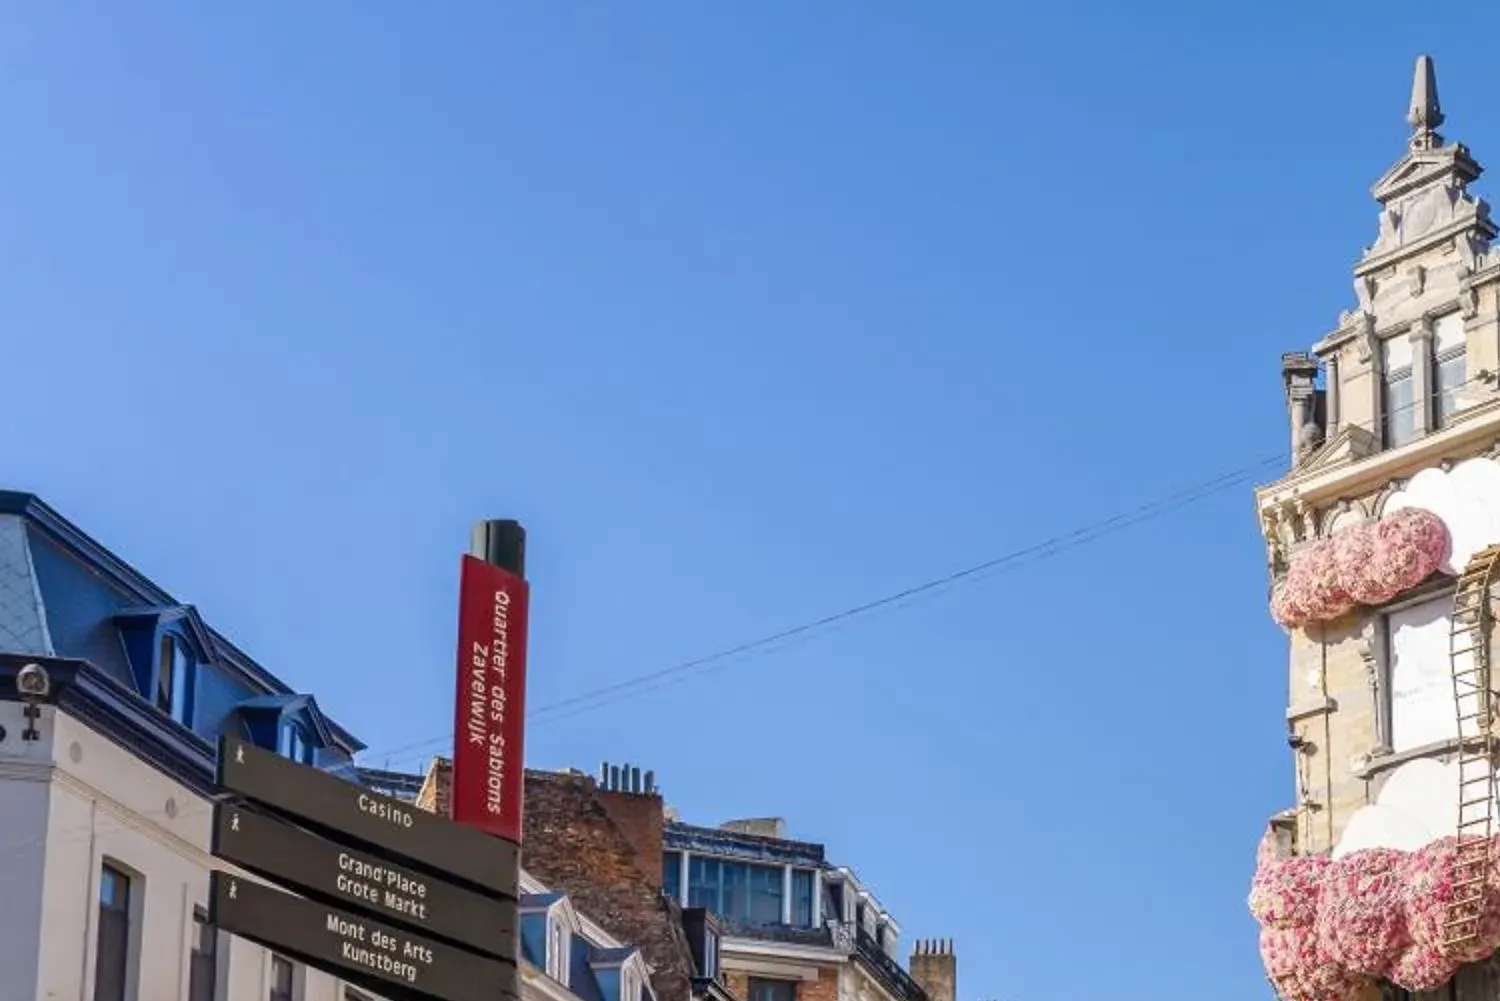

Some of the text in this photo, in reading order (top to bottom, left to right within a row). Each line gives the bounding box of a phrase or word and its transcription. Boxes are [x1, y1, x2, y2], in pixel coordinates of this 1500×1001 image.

[469, 641, 488, 746] Zavelwijk
[487, 590, 511, 815] Quartier des Sablons
[358, 793, 414, 828] Casino
[336, 874, 427, 919] Grote Markt
[338, 852, 428, 899] Grand'Place
[326, 913, 434, 964] Mont des Arts
[342, 940, 419, 983] Kunstberg
